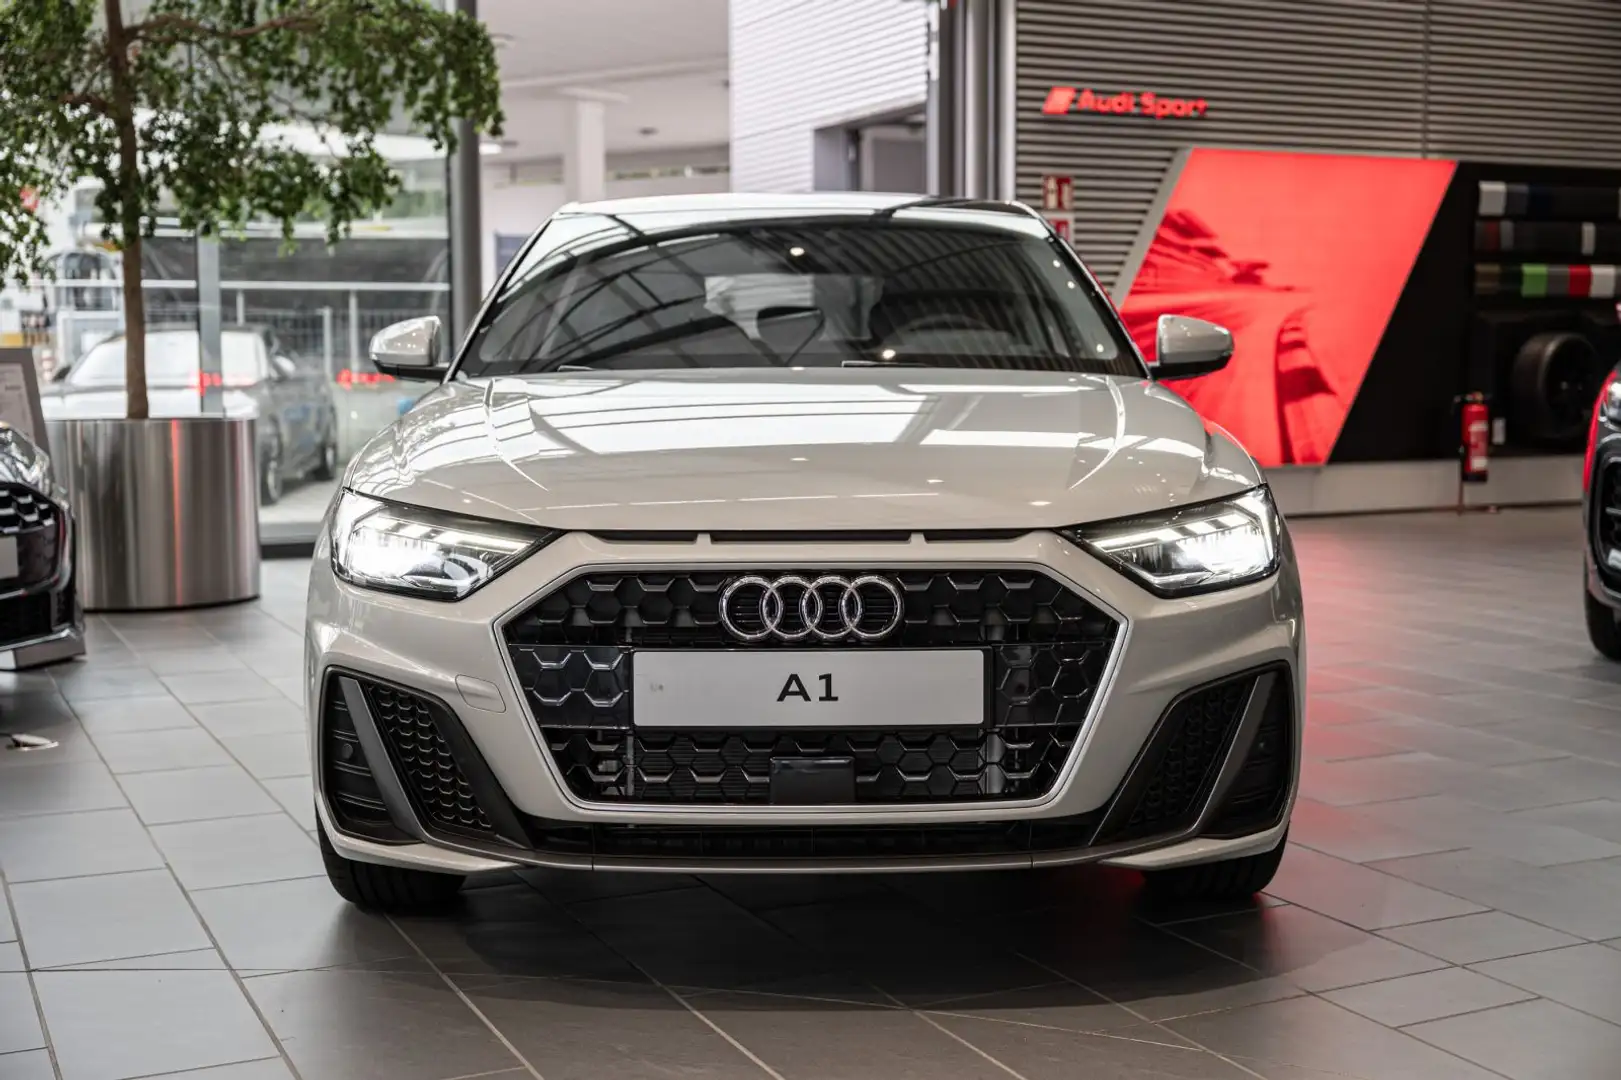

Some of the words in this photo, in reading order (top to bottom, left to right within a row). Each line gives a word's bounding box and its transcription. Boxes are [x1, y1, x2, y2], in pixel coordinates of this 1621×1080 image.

[1077, 89, 1134, 112] Audi
[1140, 91, 1207, 119] Sport
[776, 673, 838, 702] A1
